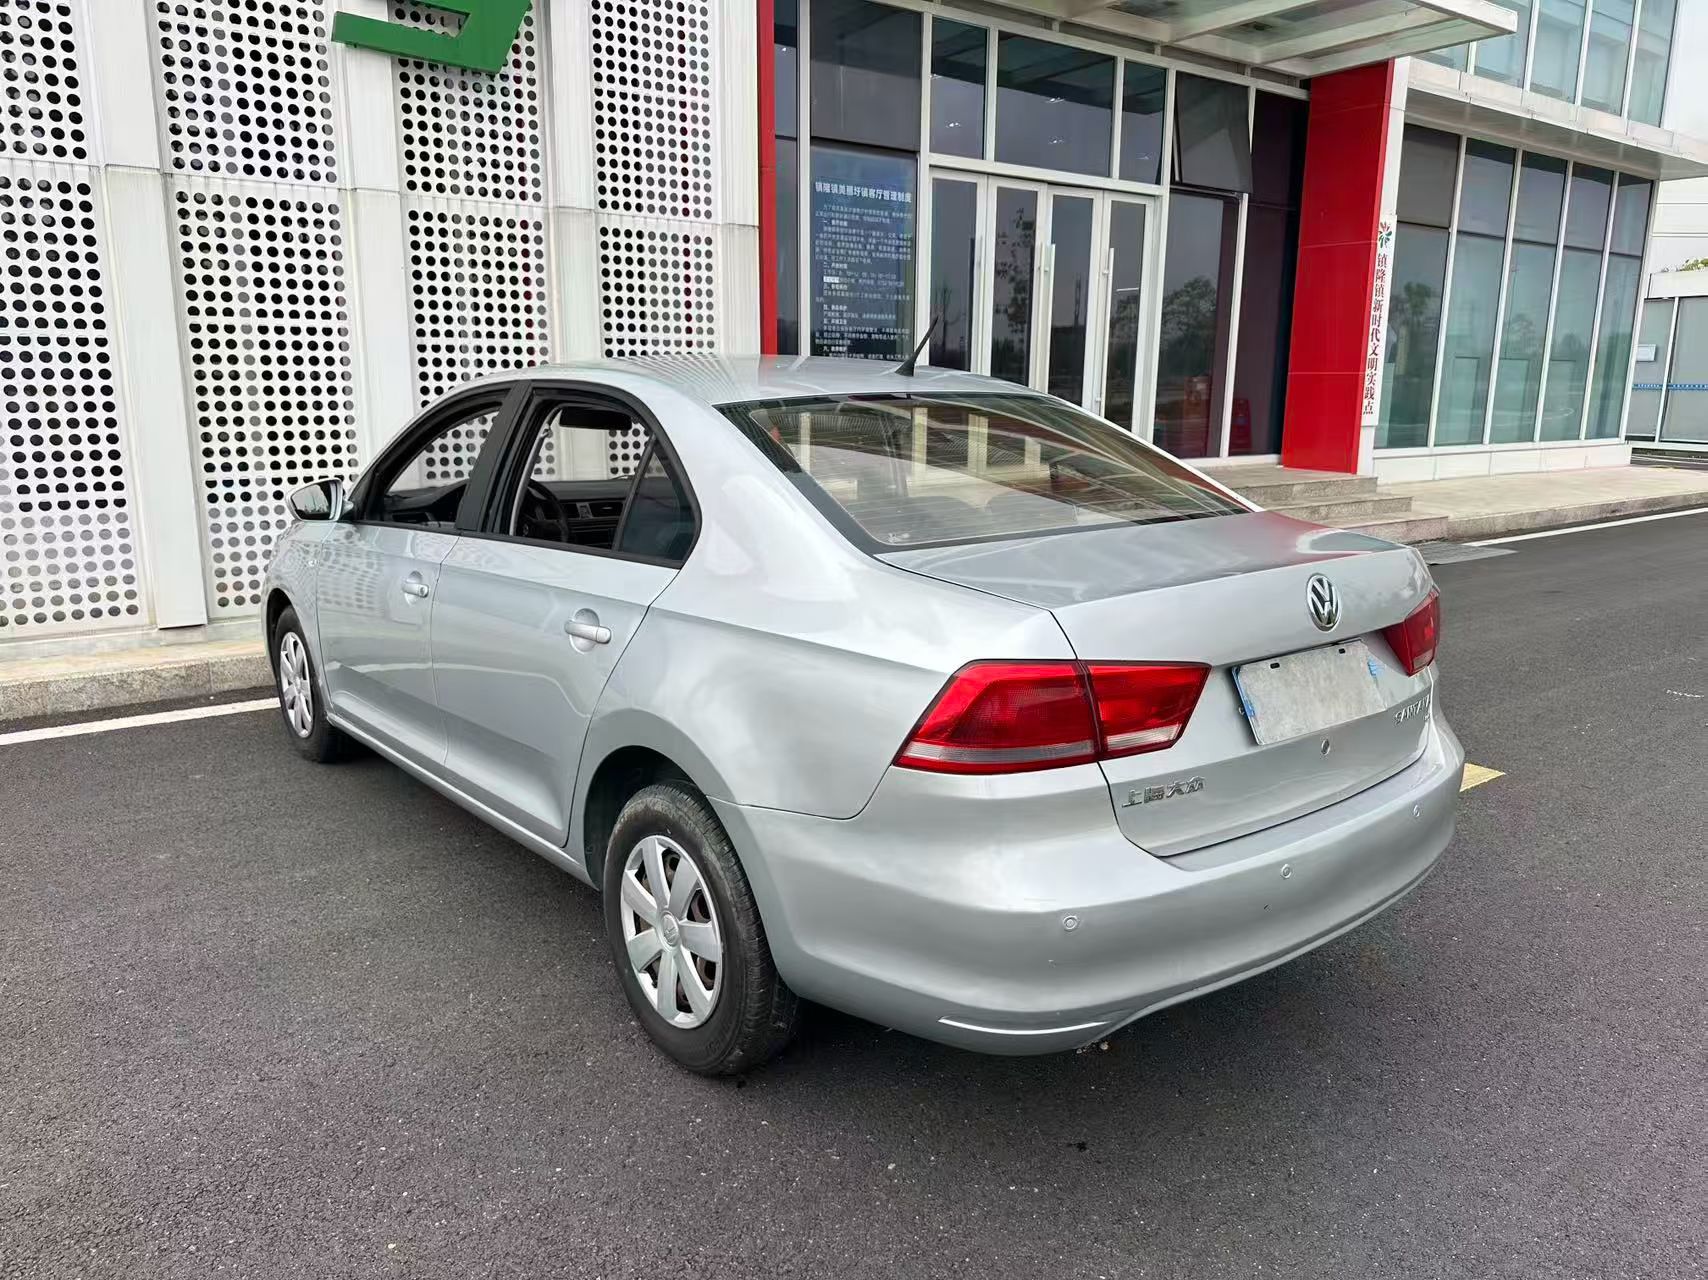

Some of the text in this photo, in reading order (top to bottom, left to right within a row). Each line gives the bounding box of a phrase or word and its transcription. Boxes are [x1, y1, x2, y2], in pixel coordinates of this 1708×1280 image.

[1363, 253, 1387, 415] 镇隆镇新时代文明实践点
